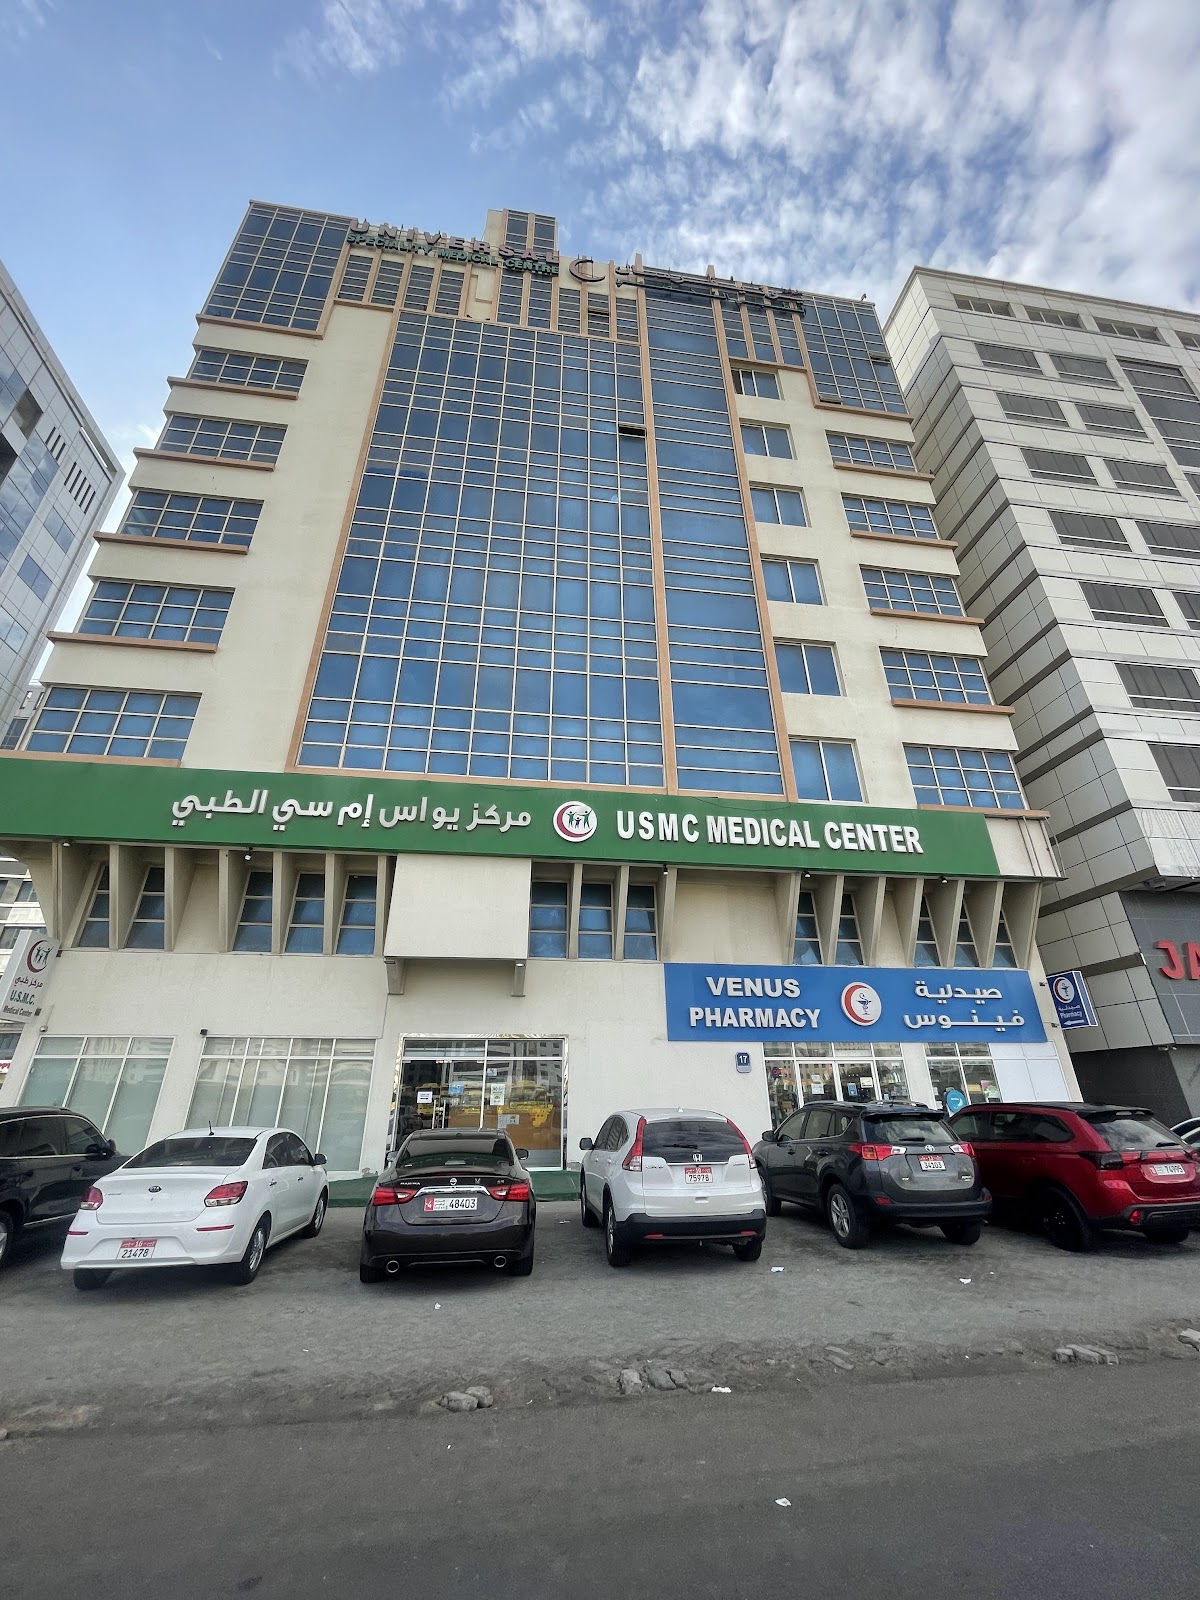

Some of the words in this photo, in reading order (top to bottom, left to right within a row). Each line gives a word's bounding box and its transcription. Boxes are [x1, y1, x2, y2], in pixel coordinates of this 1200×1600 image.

[350, 218, 559, 264] UNIVERSAL
[347, 234, 432, 255] SPECIALITY
[438, 248, 498, 267] MEDICAL
[504, 258, 559, 275] CENTRE
[172, 789, 269, 827] الطبي
[272, 796, 333, 831] سي
[466, 803, 532, 833] مركز
[616, 810, 699, 843] USMC
[706, 815, 820, 848] MEDICAL
[824, 822, 924, 854] CENTER
[705, 976, 801, 998] VENUS
[915, 980, 1003, 1006] صيدلية
[3, 1005, 19, 1015] Medical
[19, 1008, 33, 1018] Center
[689, 1007, 821, 1029] PHARMACY
[903, 1010, 1025, 1033] فينوس
[738, 1055, 748, 1064] 17
[688, 1174, 710, 1182] 75978
[449, 1199, 476, 1209] 48403
[121, 1248, 150, 1259] 21478
